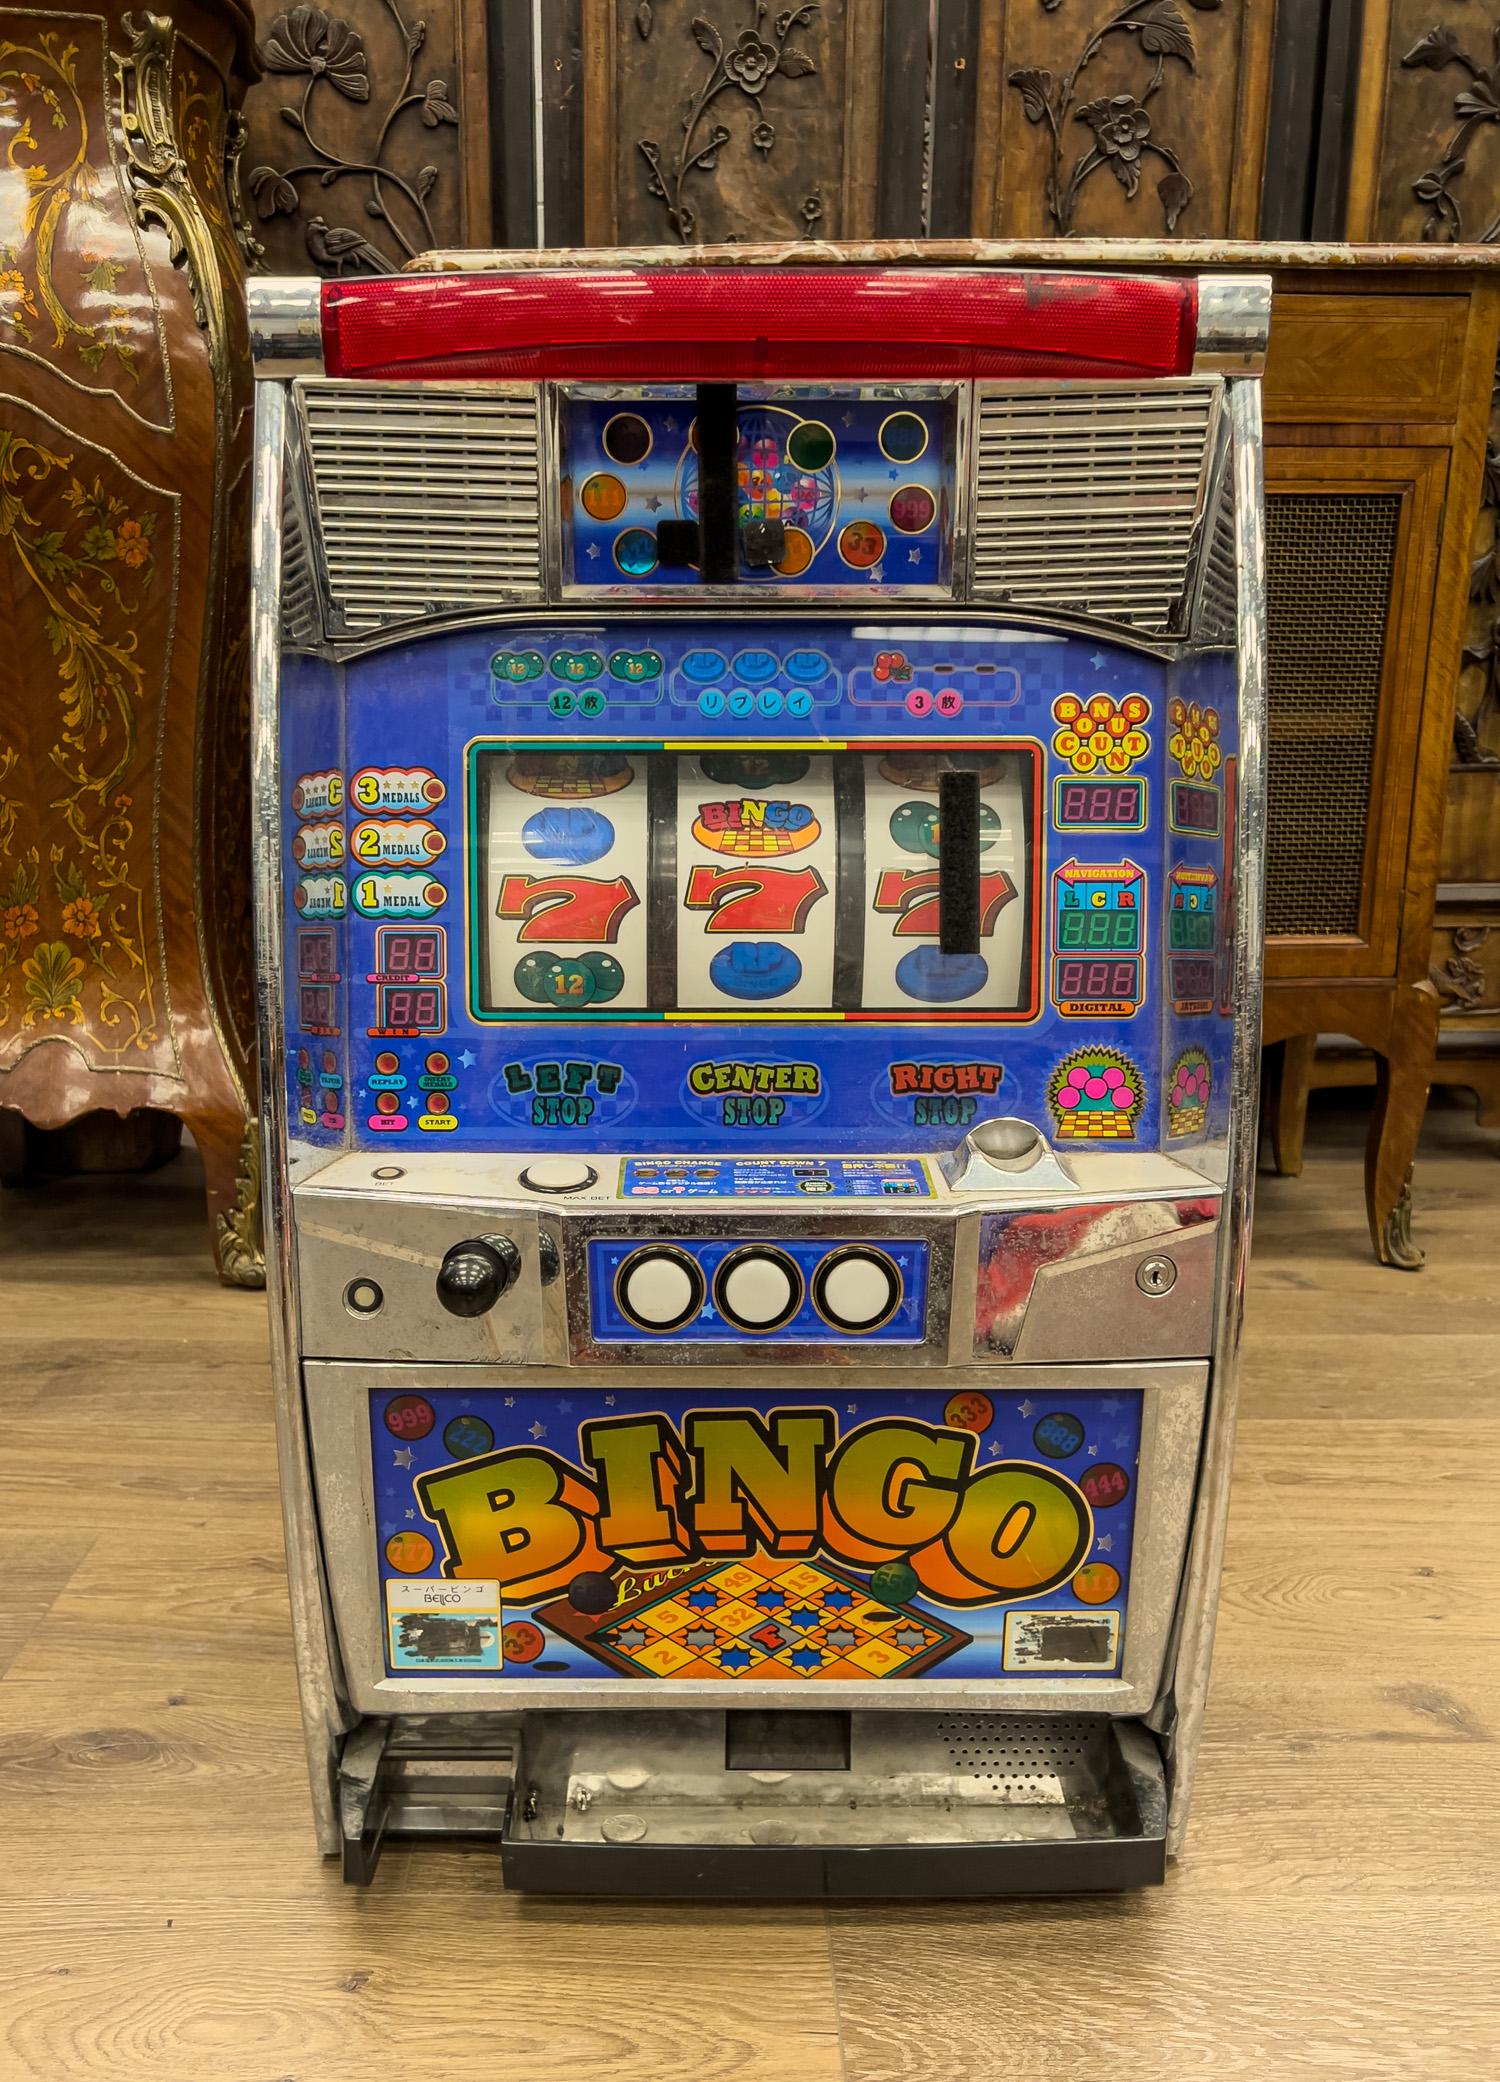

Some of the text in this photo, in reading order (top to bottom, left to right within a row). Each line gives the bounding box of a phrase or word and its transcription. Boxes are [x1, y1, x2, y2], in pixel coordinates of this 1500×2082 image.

[510, 663, 525, 675] 12
[569, 663, 584, 675] 12
[628, 663, 643, 675] 12
[1058, 701, 1144, 735] BONUS
[1058, 735, 1143, 769] COUNT
[358, 776, 421, 805] 3 MEDALS
[699, 798, 817, 832] BINGO
[358, 828, 421, 857] 2 MEDALS
[1064, 868, 1136, 880] NAVIGATION
[361, 880, 421, 907] 1 MEDAL
[684, 864, 829, 934] 7
[1064, 891, 1135, 908] L C R
[496, 873, 641, 944] 7
[554, 974, 584, 995] 12
[1069, 1002, 1125, 1014] DIGITAL
[371, 1078, 405, 1086] REPLAY
[502, 1062, 625, 1095] LEFT
[689, 1062, 822, 1097] CENTER
[890, 1062, 1003, 1096] RIGHT
[531, 1096, 596, 1127] STOP
[722, 1096, 785, 1127] STOP
[914, 1096, 977, 1127] STOP
[388, 1404, 430, 1432] 999
[949, 1397, 989, 1429] 333
[1038, 1419, 1079, 1452] 888
[1084, 1471, 1125, 1498] 444
[418, 1411, 1090, 1607] BINGO
[389, 1543, 430, 1562] 777
[401, 1585, 484, 1593] スーパービンゴ
[724, 1571, 755, 1590] 49
[788, 1571, 820, 1591] 15
[664, 1610, 680, 1625] 5
[720, 1607, 755, 1628] 32
[503, 1628, 537, 1656] 33
[654, 1650, 679, 1665] 2
[867, 1650, 890, 1664] 3
